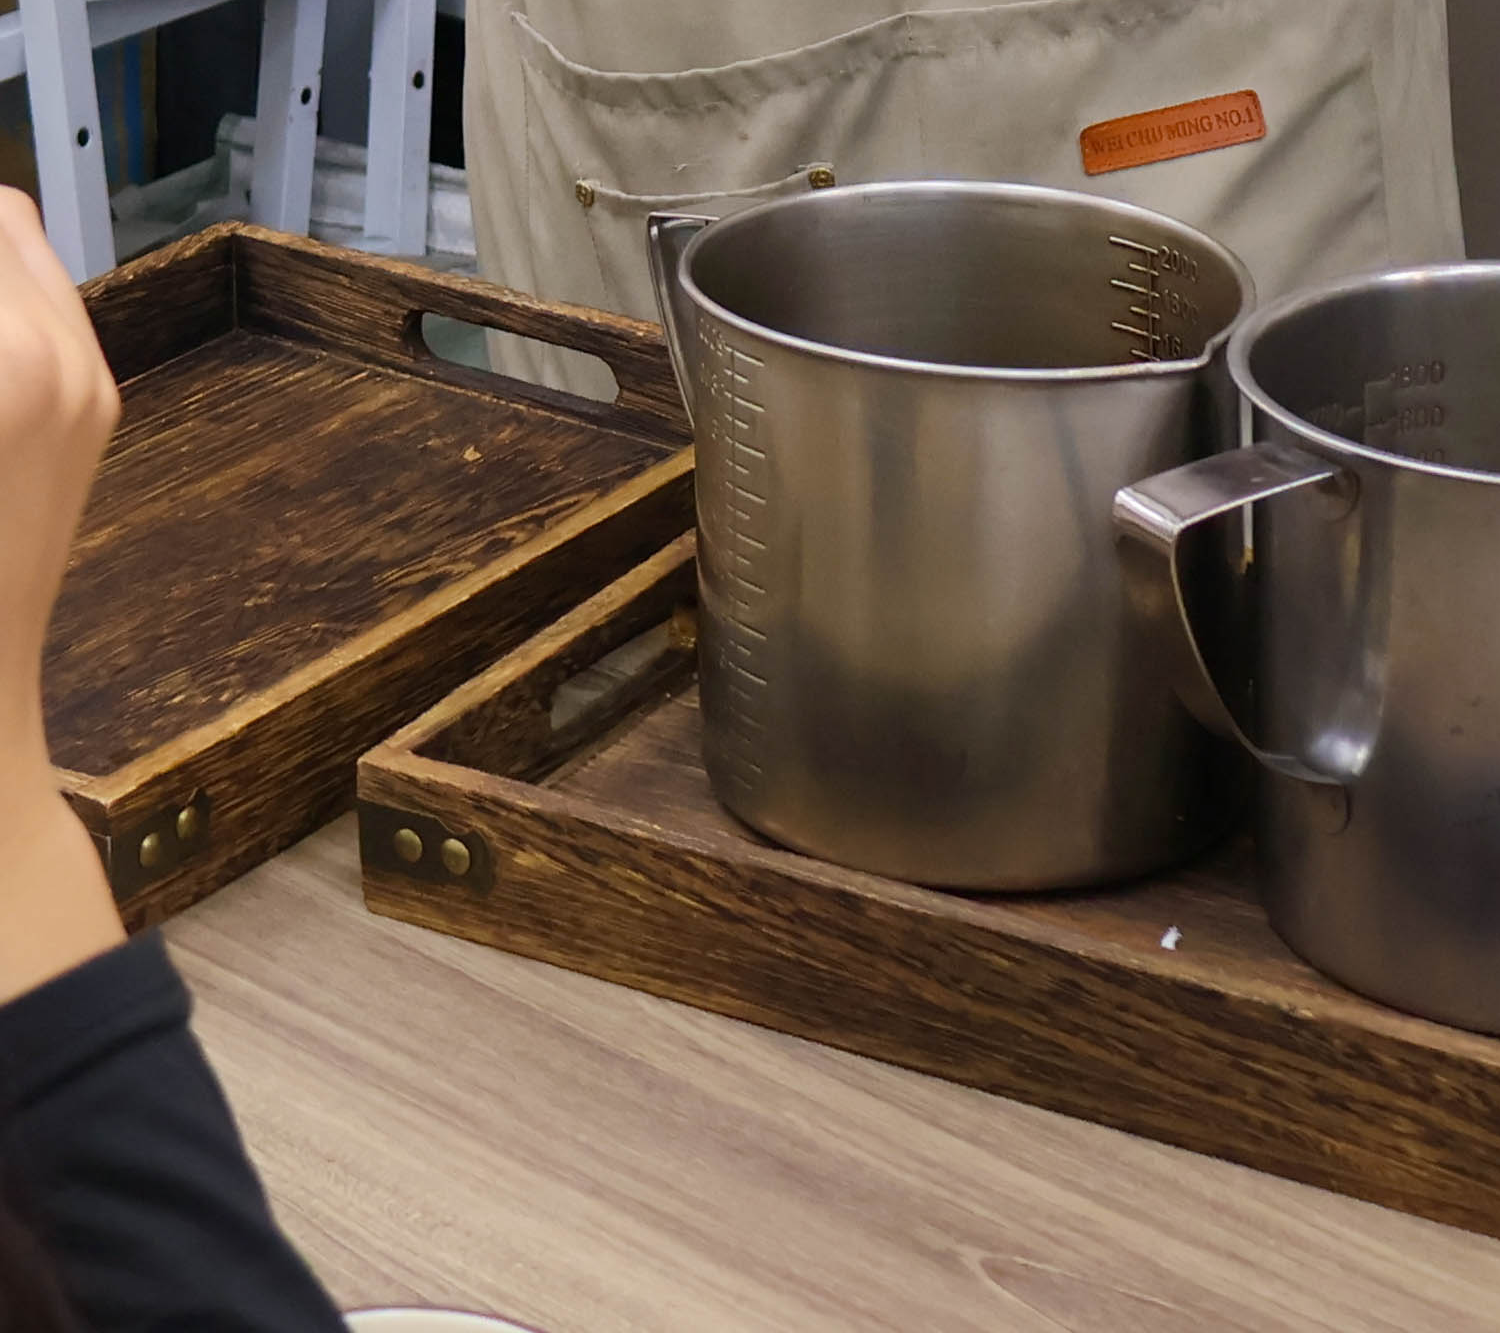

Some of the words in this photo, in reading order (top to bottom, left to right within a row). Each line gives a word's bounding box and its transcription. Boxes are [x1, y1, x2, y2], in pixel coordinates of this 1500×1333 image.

[1091, 137, 1123, 155] WEI
[1126, 126, 1164, 149] CHU
[1166, 115, 1213, 141] MING
[1215, 107, 1256, 130] NO.1
[1161, 245, 1199, 284] 2000
